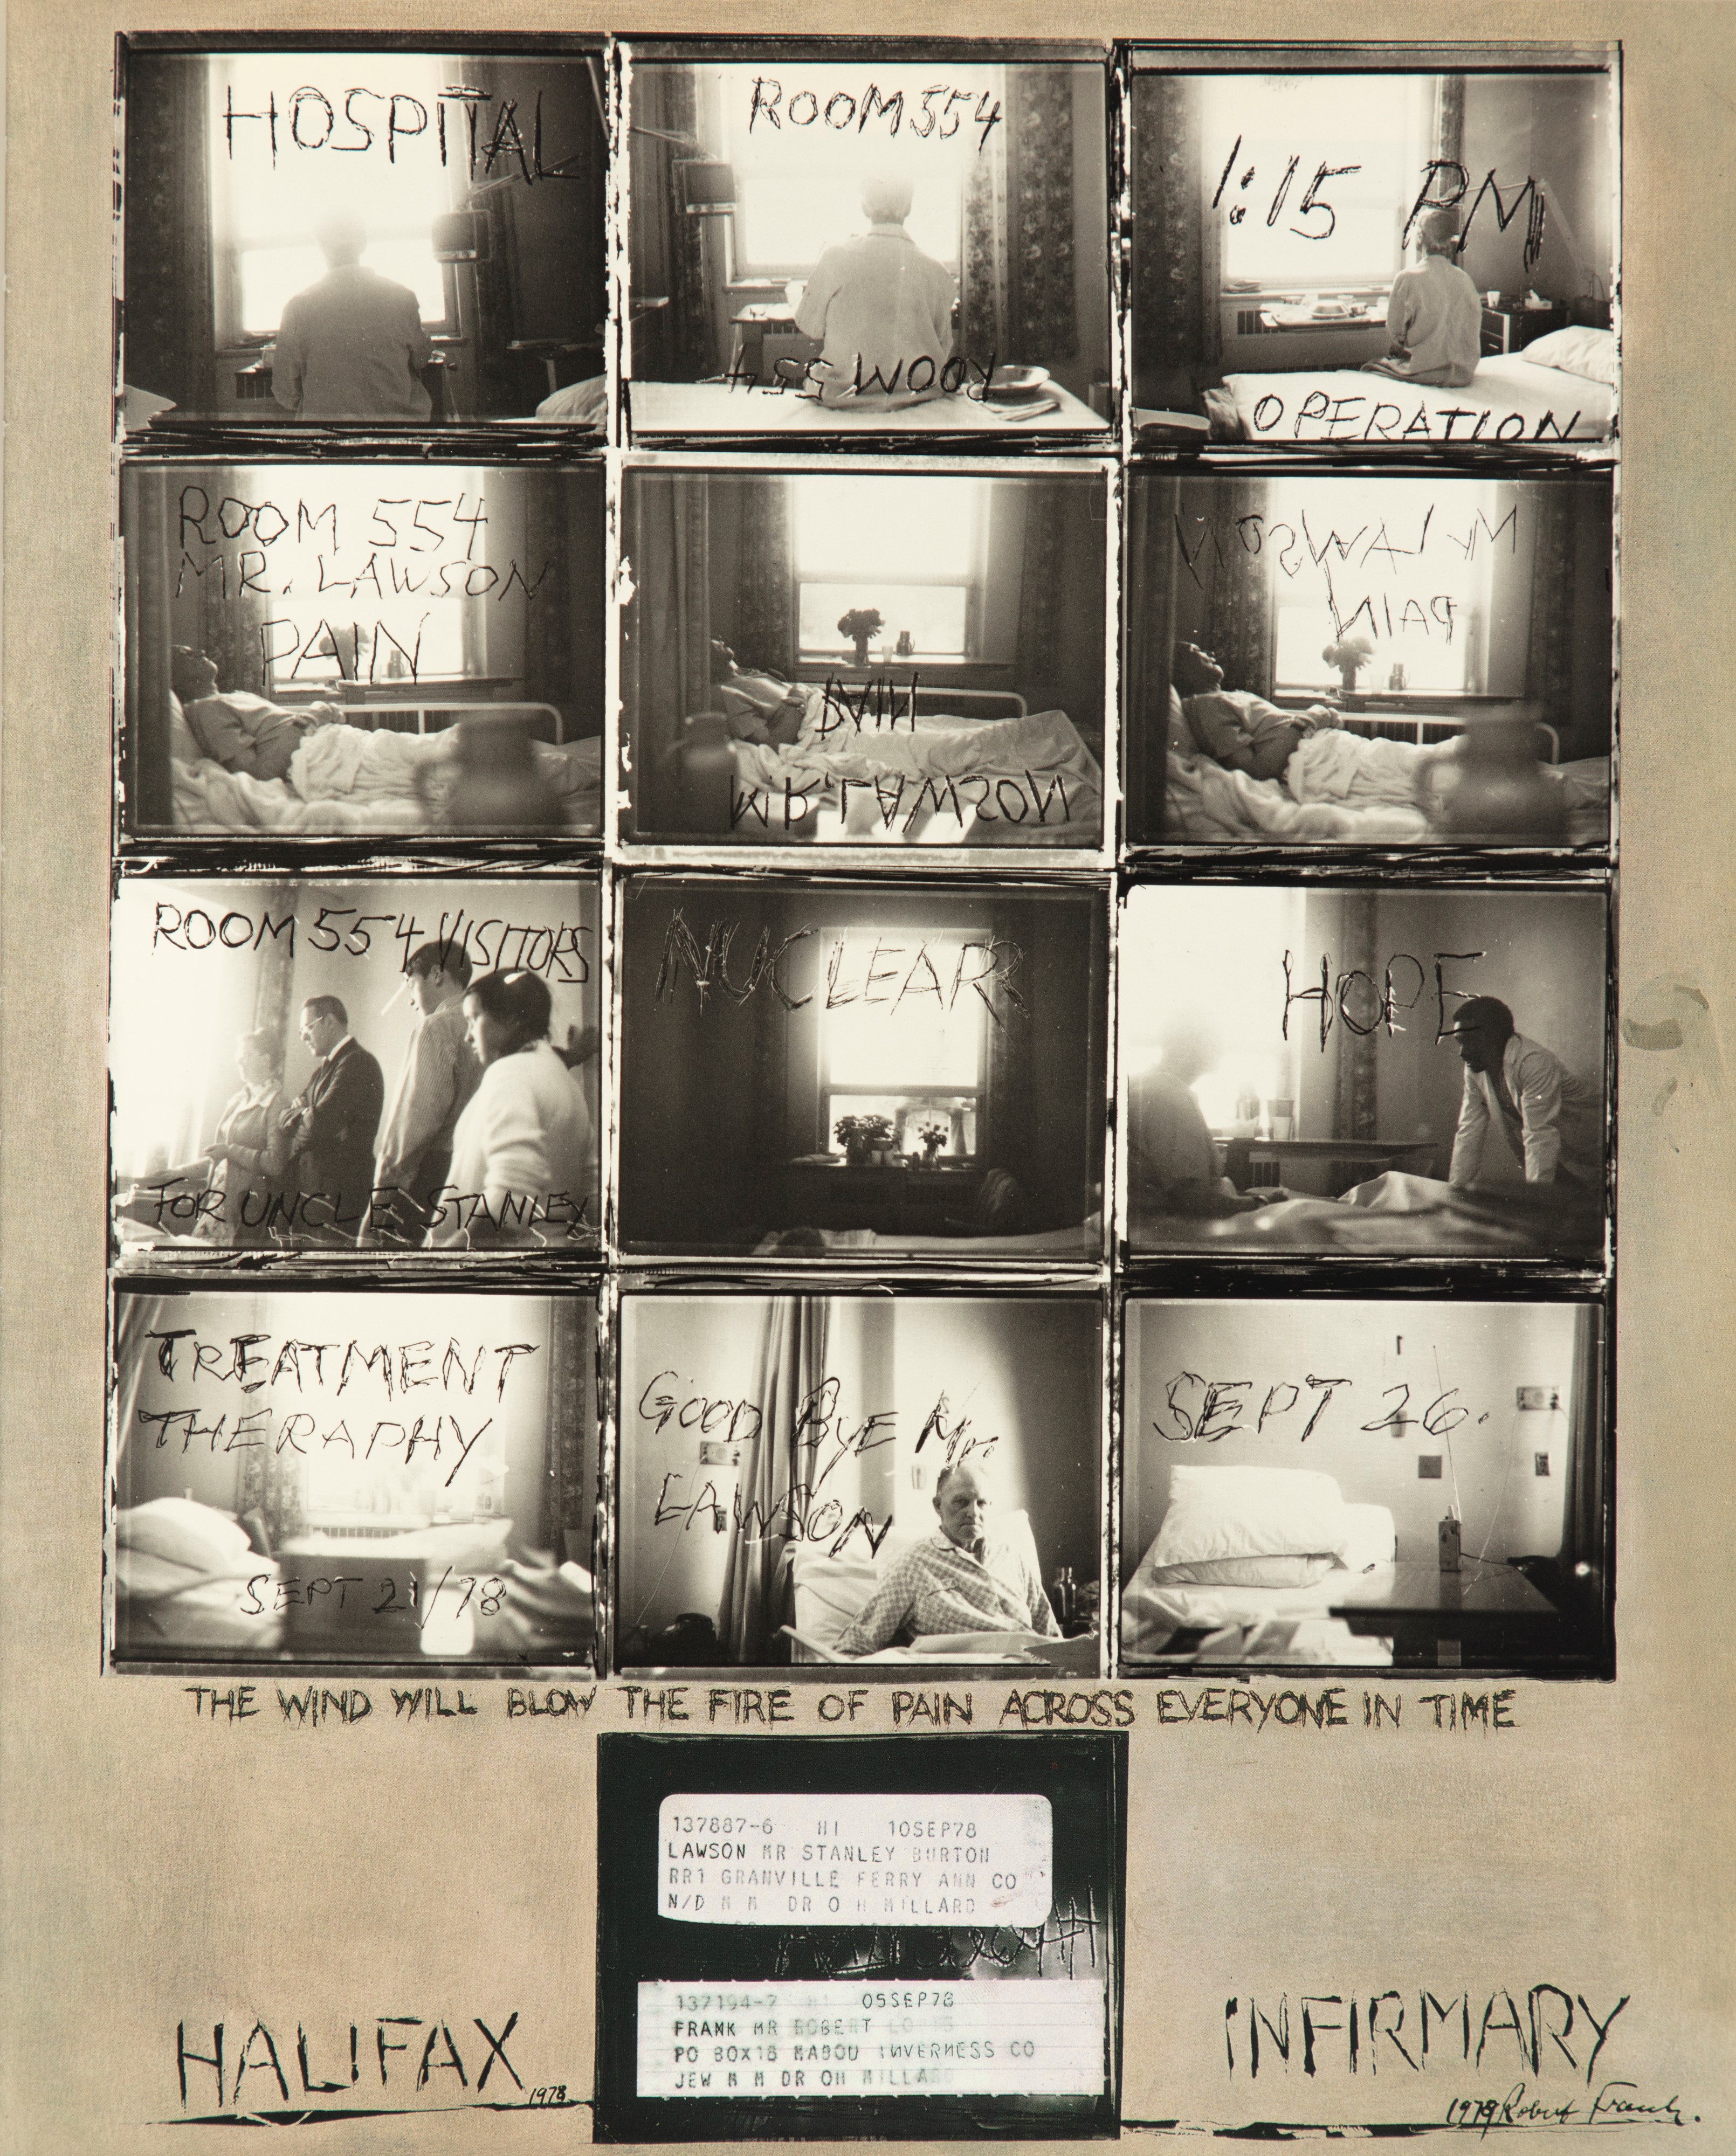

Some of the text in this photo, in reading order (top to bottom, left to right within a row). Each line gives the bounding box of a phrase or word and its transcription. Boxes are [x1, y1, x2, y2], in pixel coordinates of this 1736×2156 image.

[222, 85, 580, 185] HOSPITAL
[748, 76, 1003, 156] ROOM 554
[1212, 134, 1545, 273] 1:15 PM
[1253, 390, 1581, 441] OPERATION
[179, 486, 488, 560] ROOM 554
[175, 550, 553, 601] MR. LAWSON
[260, 612, 430, 687] PAIN
[152, 902, 594, 983] ROOM 554 VISITORS
[654, 907, 1030, 1032] NUCLEAR
[1282, 949, 1486, 1053] HOPE
[148, 1177, 588, 1235] FOR UNCLE STANLEY
[145, 1330, 541, 1402] TREATMENT
[1153, 1371, 1352, 1443] SEPT
[137, 1409, 493, 1487] THERAPHY
[653, 1473, 892, 1559] LAWSON
[239, 1574, 365, 1616] SEPT
[182, 1681, 1518, 1733] THE WIND WILL BLOW THE FIRE OF PAIN ACROSS EVERYONE IN TIME
[669, 1842, 989, 1863] LAWSON MR STANLEY BURTON
[674, 1816, 977, 1838] 137887-6 HI 10SEP78
[668, 1894, 704, 1911] N/D
[788, 1896, 811, 1912] DR
[885, 1898, 975, 1913] MILLARD
[670, 1868, 1017, 1889] RR1 GRANVILLE FERRY ANN CO
[674, 2020, 736, 2037] FRANK
[754, 2020, 778, 2036] MR
[862, 1992, 954, 2010] 05SEP78
[1225, 1985, 1630, 2088] INFIRMARY
[176, 2012, 567, 2112] HALIFAX 1978
[674, 2046, 699, 2063] PO
[794, 2044, 858, 2062] MABOU
[880, 2041, 995, 2058] INVERNESS
[1010, 2040, 1035, 2058] CO
[675, 2071, 712, 2089] JEW
[782, 2070, 805, 2087] DR
